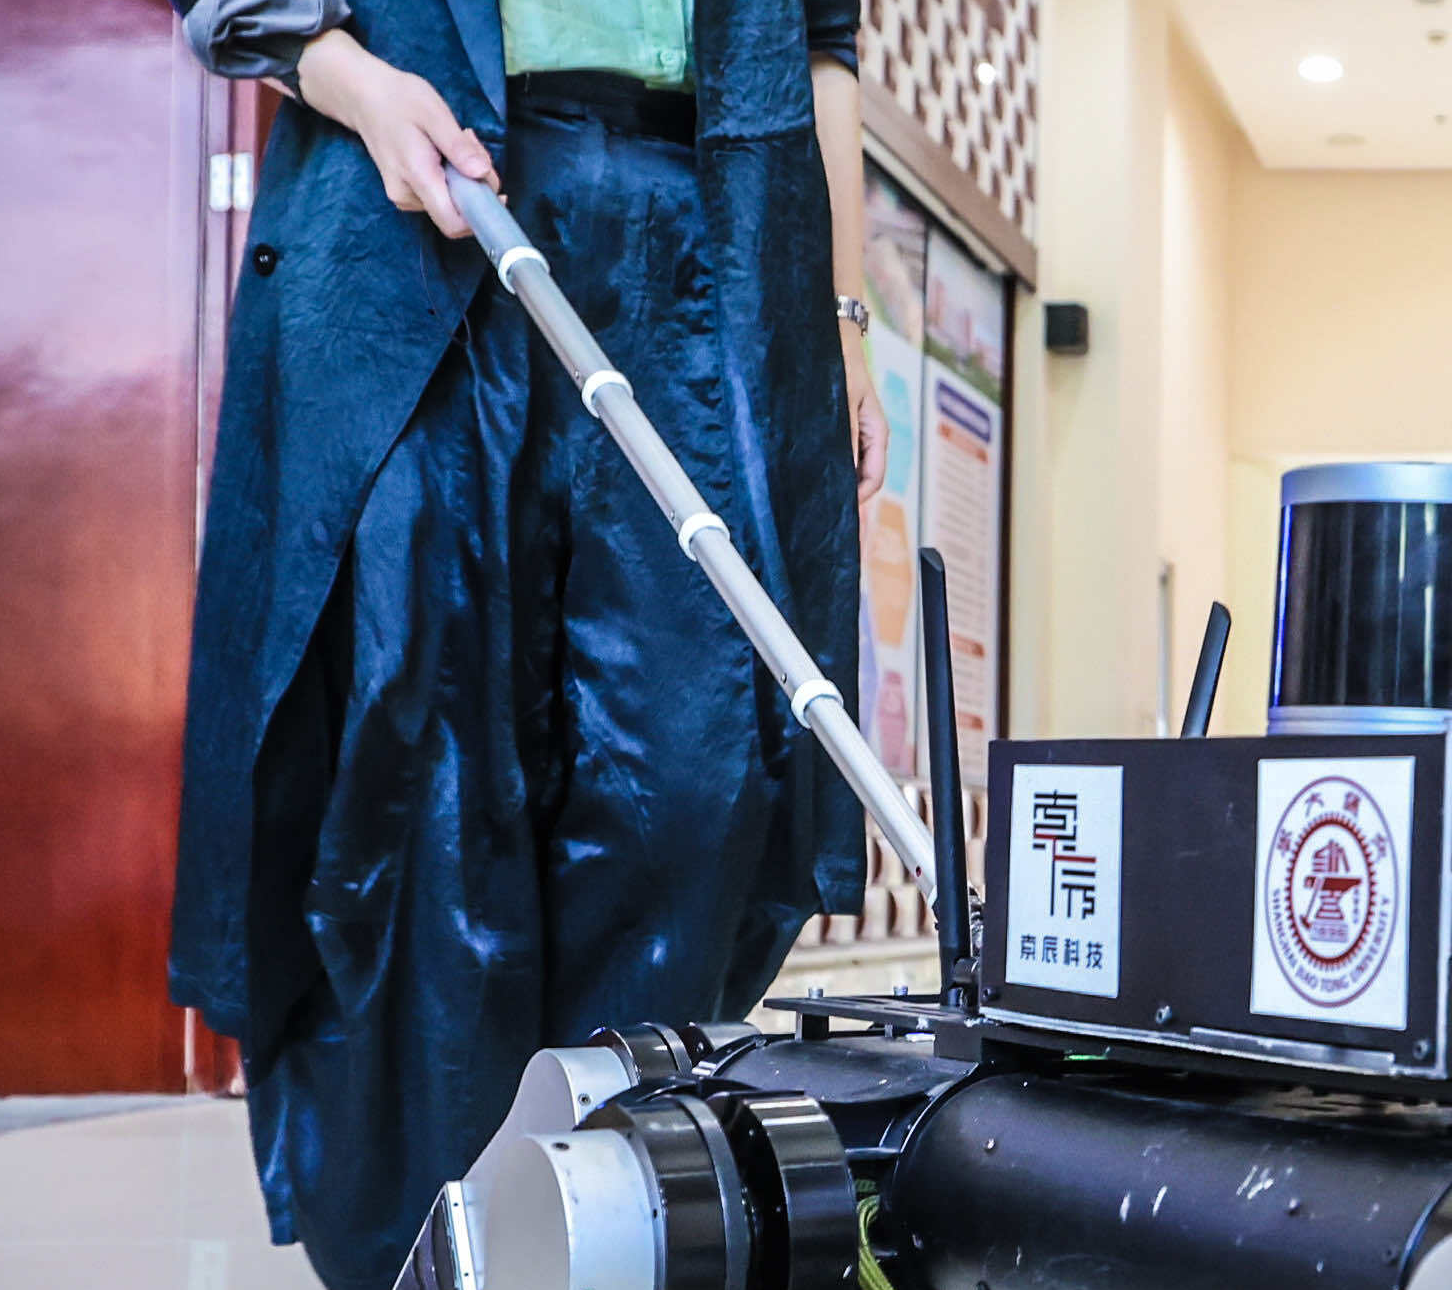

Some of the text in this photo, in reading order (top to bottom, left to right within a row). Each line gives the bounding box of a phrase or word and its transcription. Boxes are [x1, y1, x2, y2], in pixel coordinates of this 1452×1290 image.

[1020, 934, 1103, 970] 索辰科技
[1320, 976, 1350, 993] TONG
